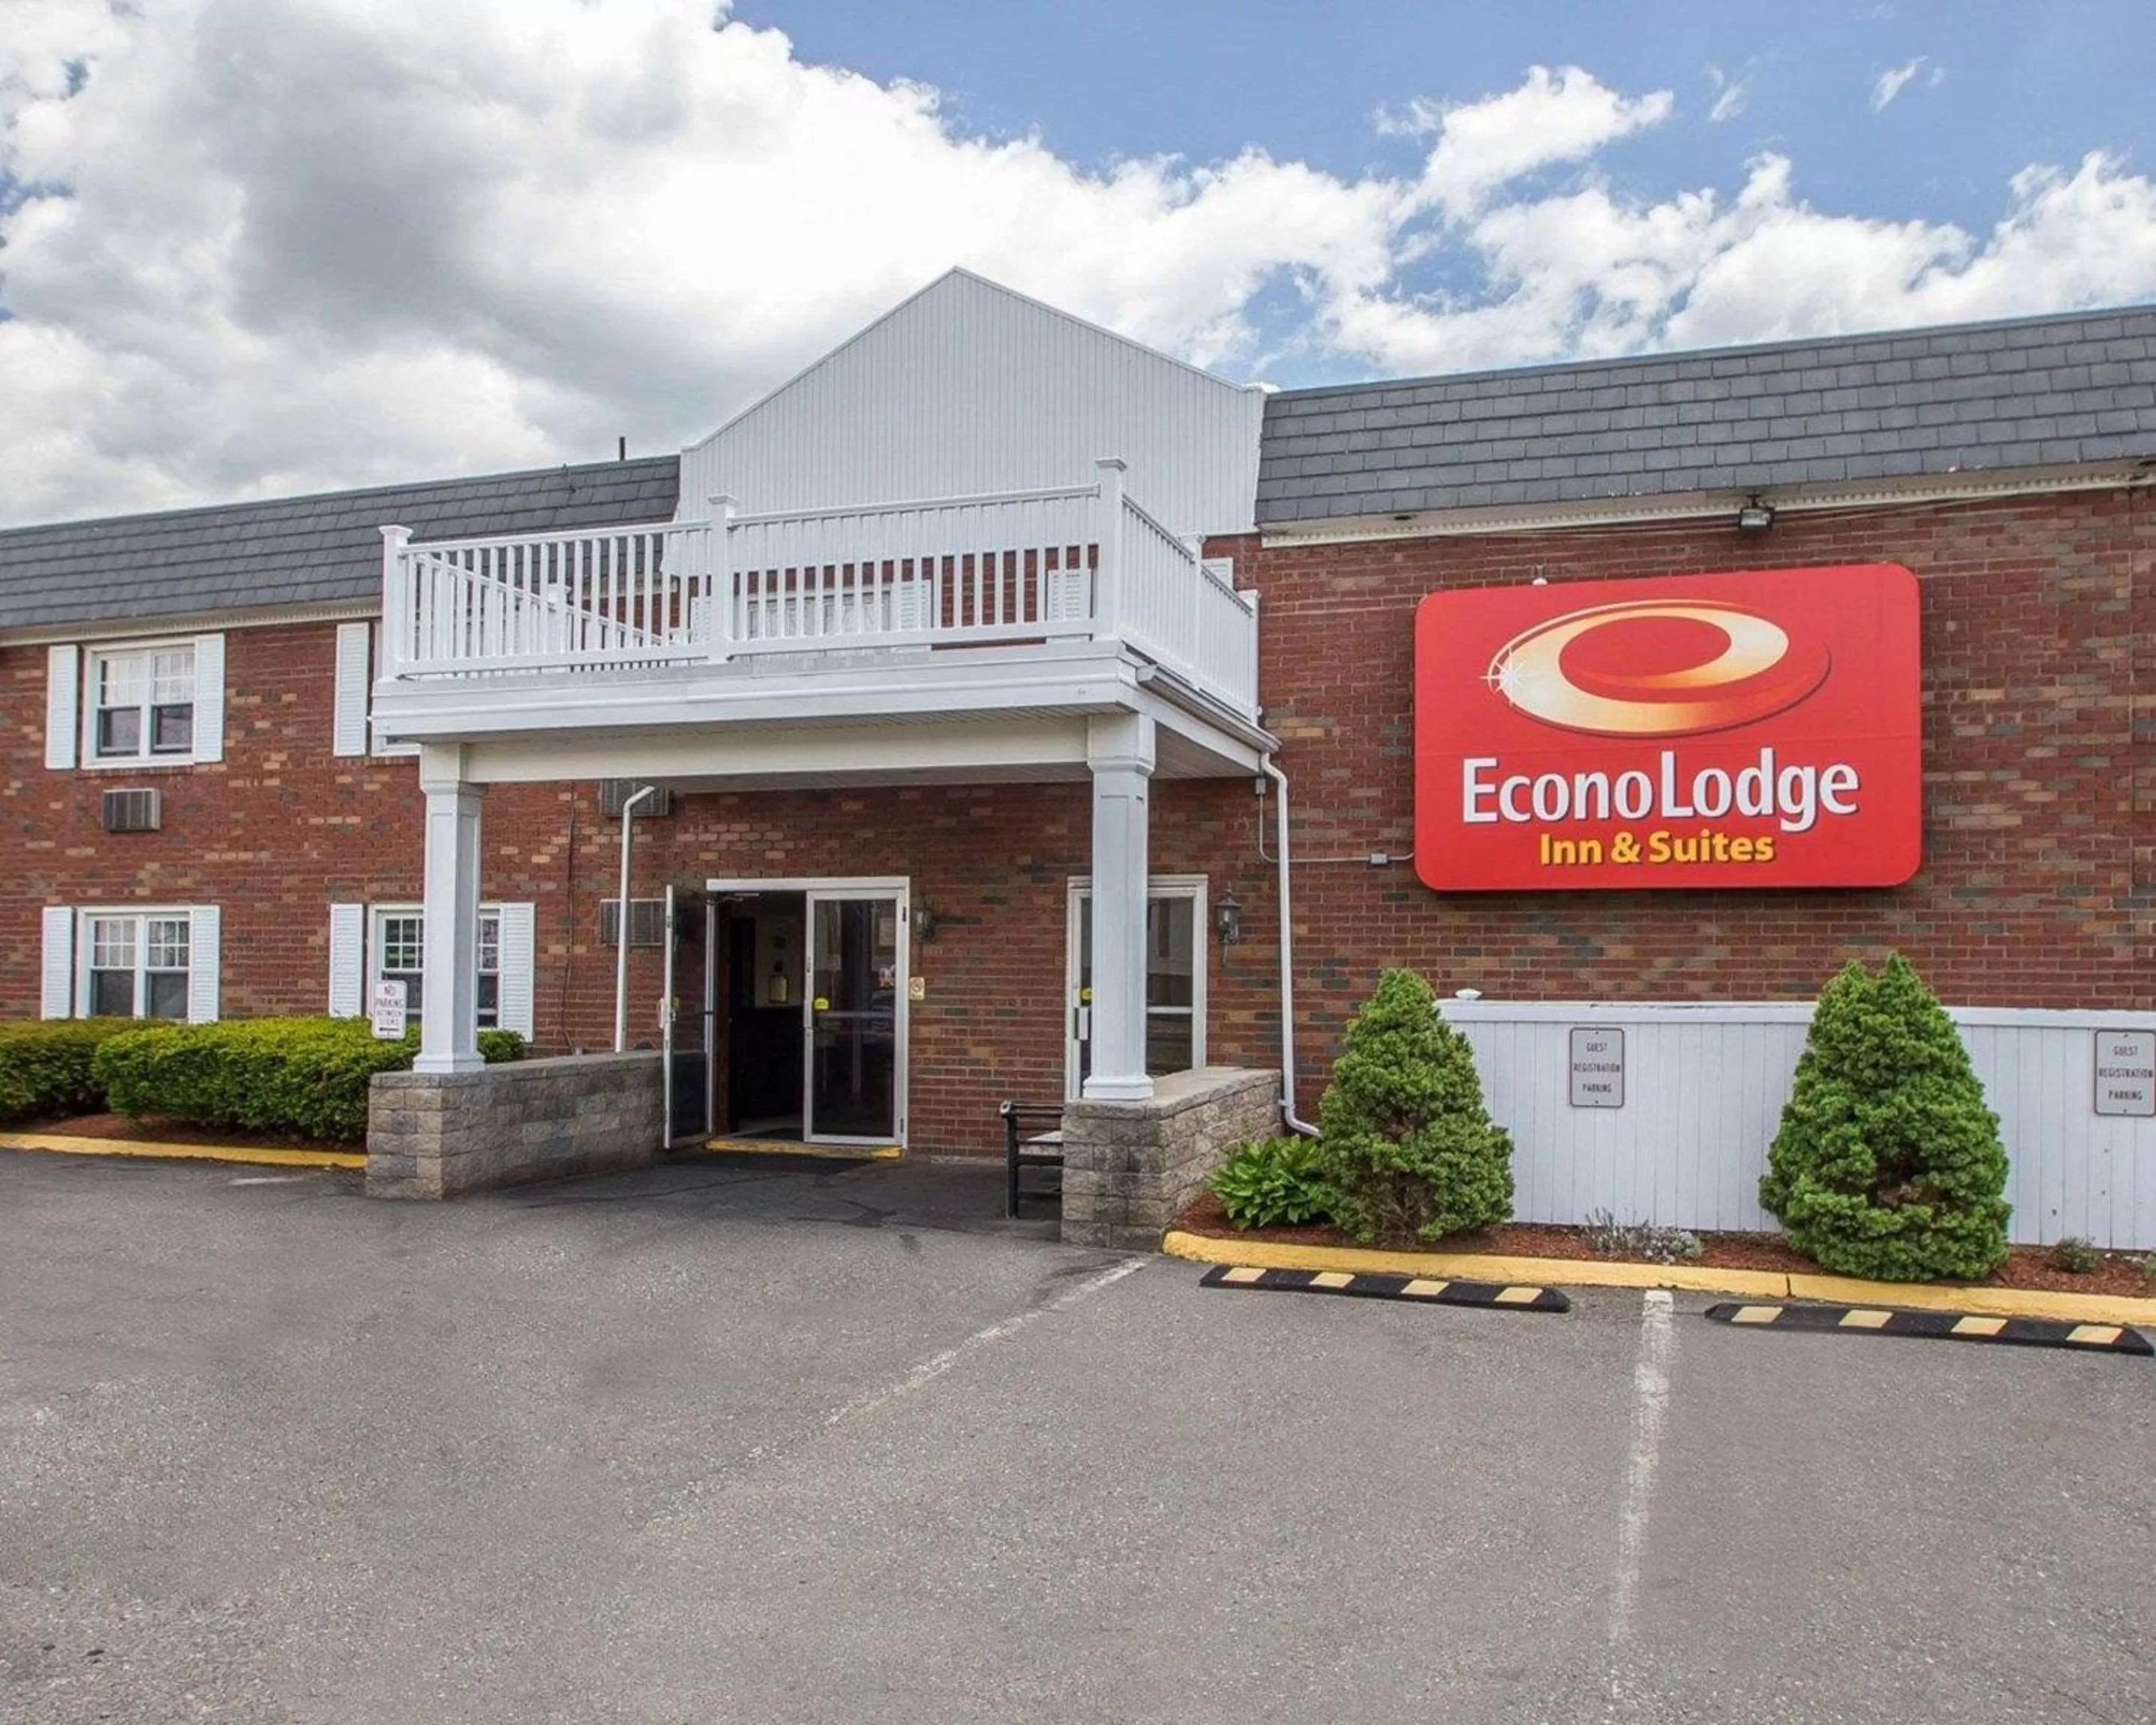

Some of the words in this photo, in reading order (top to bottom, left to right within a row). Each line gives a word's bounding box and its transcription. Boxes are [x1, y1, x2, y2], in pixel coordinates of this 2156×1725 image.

[1540, 833, 1602, 865] Inn
[1610, 831, 1642, 864] &
[1648, 828, 1775, 864] Suites
[1586, 1042, 1608, 1052] GUEST
[2113, 1046, 2139, 1056] GUEST
[1574, 1062, 1620, 1072] REGISTRATION
[2098, 1068, 2153, 1078] REGISTRATION
[1583, 1083, 1612, 1093] PARKING
[2108, 1090, 2143, 1101] PARKING
